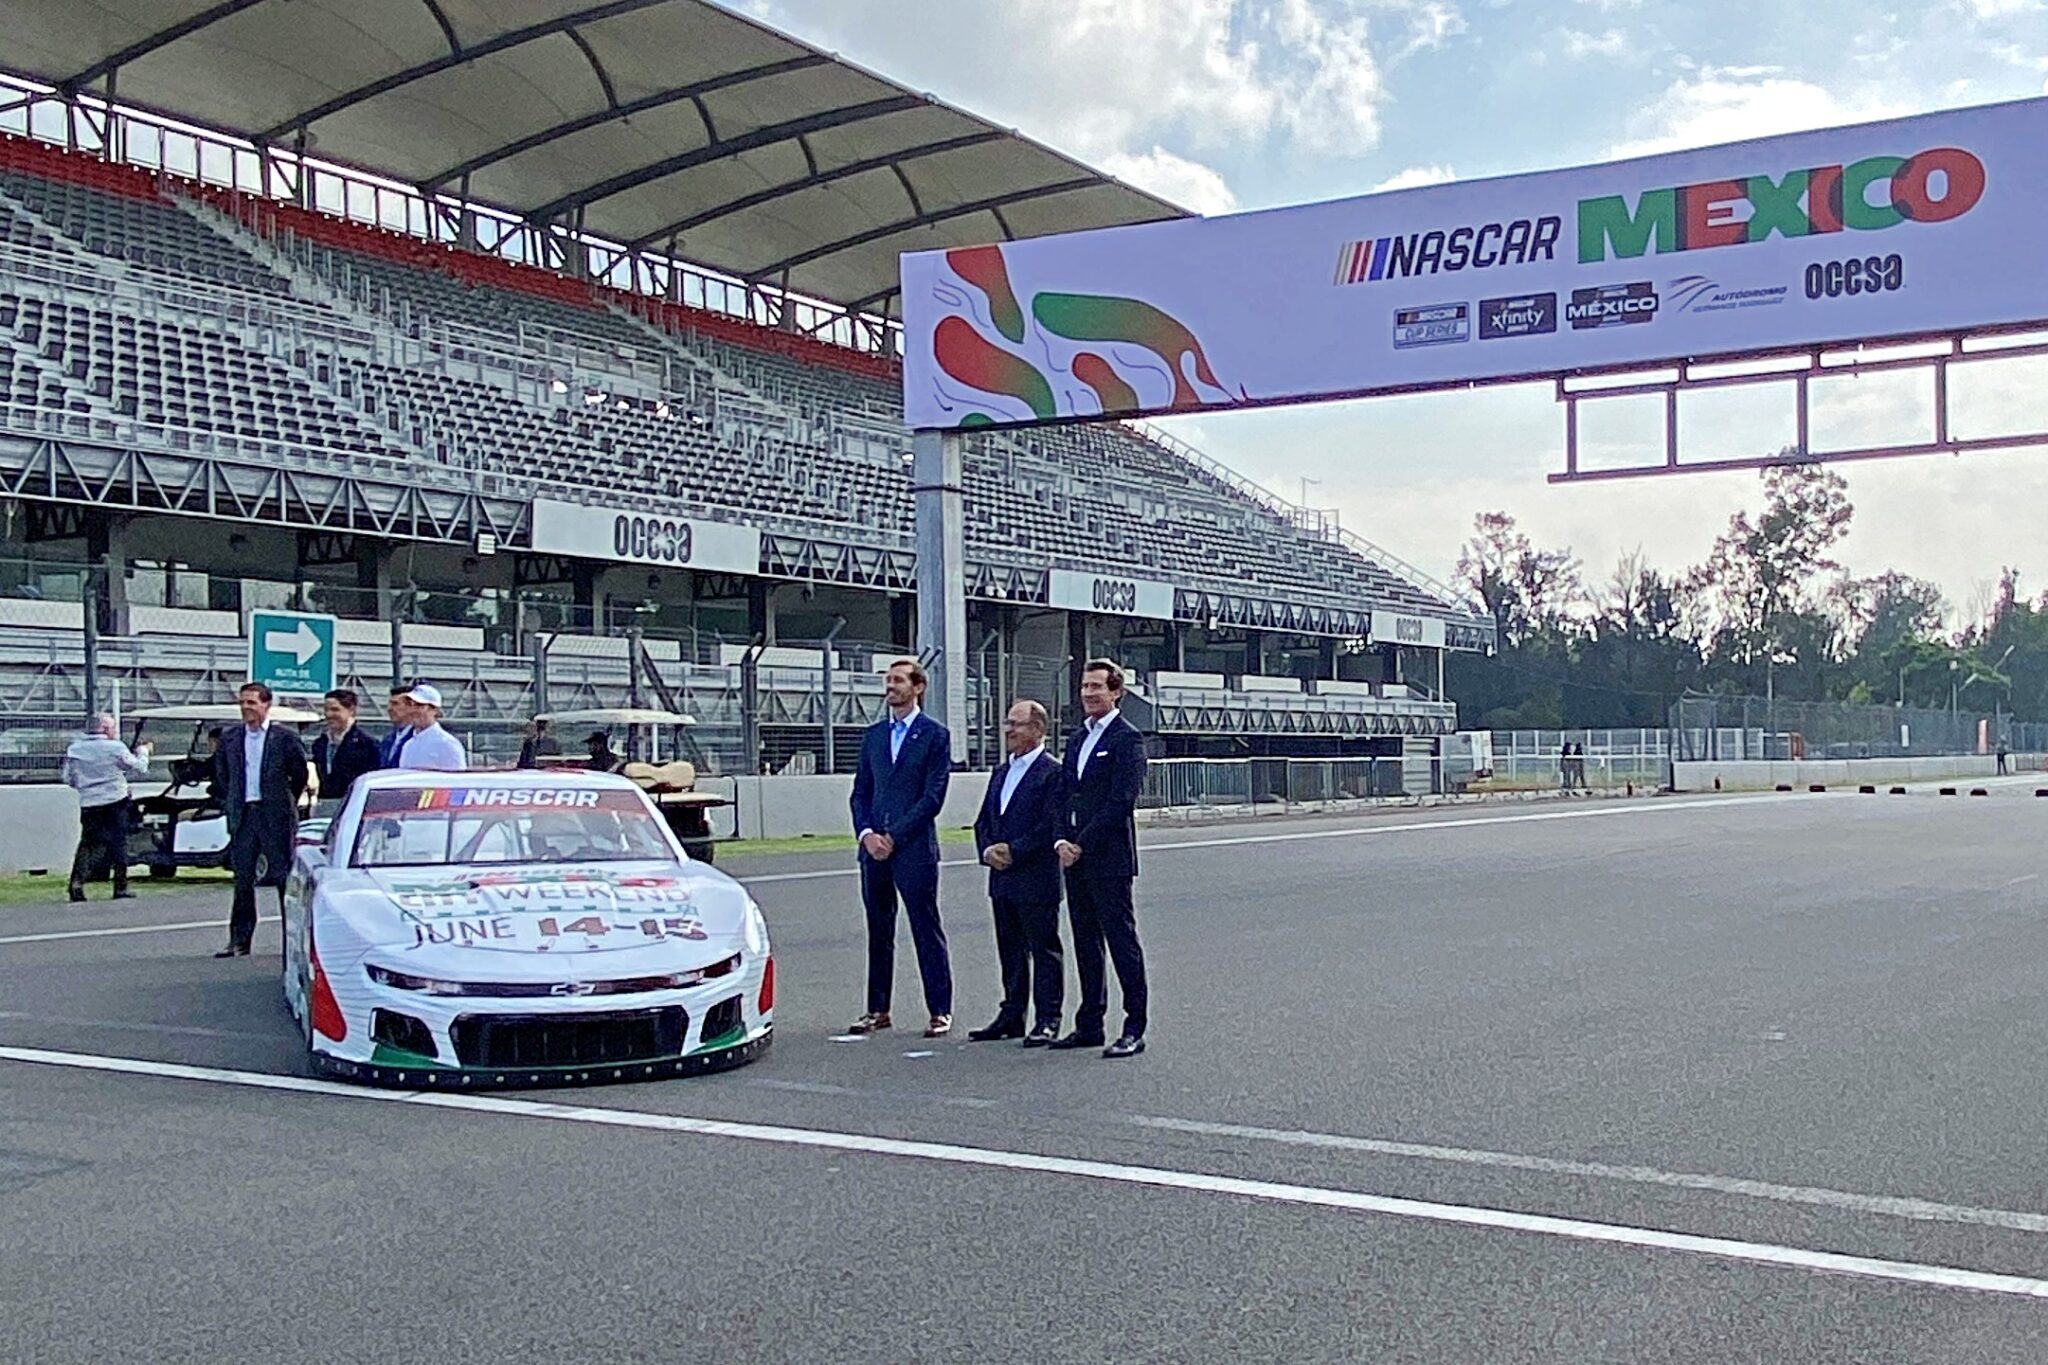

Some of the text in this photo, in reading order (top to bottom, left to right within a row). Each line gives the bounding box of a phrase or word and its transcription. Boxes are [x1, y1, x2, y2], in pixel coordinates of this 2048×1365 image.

[1386, 147, 1986, 279] NASCAR MEXICO
[1567, 296, 1657, 319] MÉXICO
[1491, 308, 1545, 331] xfinity
[463, 788, 600, 808] NASCAR
[496, 883, 690, 903] WEEKEND
[404, 915, 709, 951] JUNE 14-15
